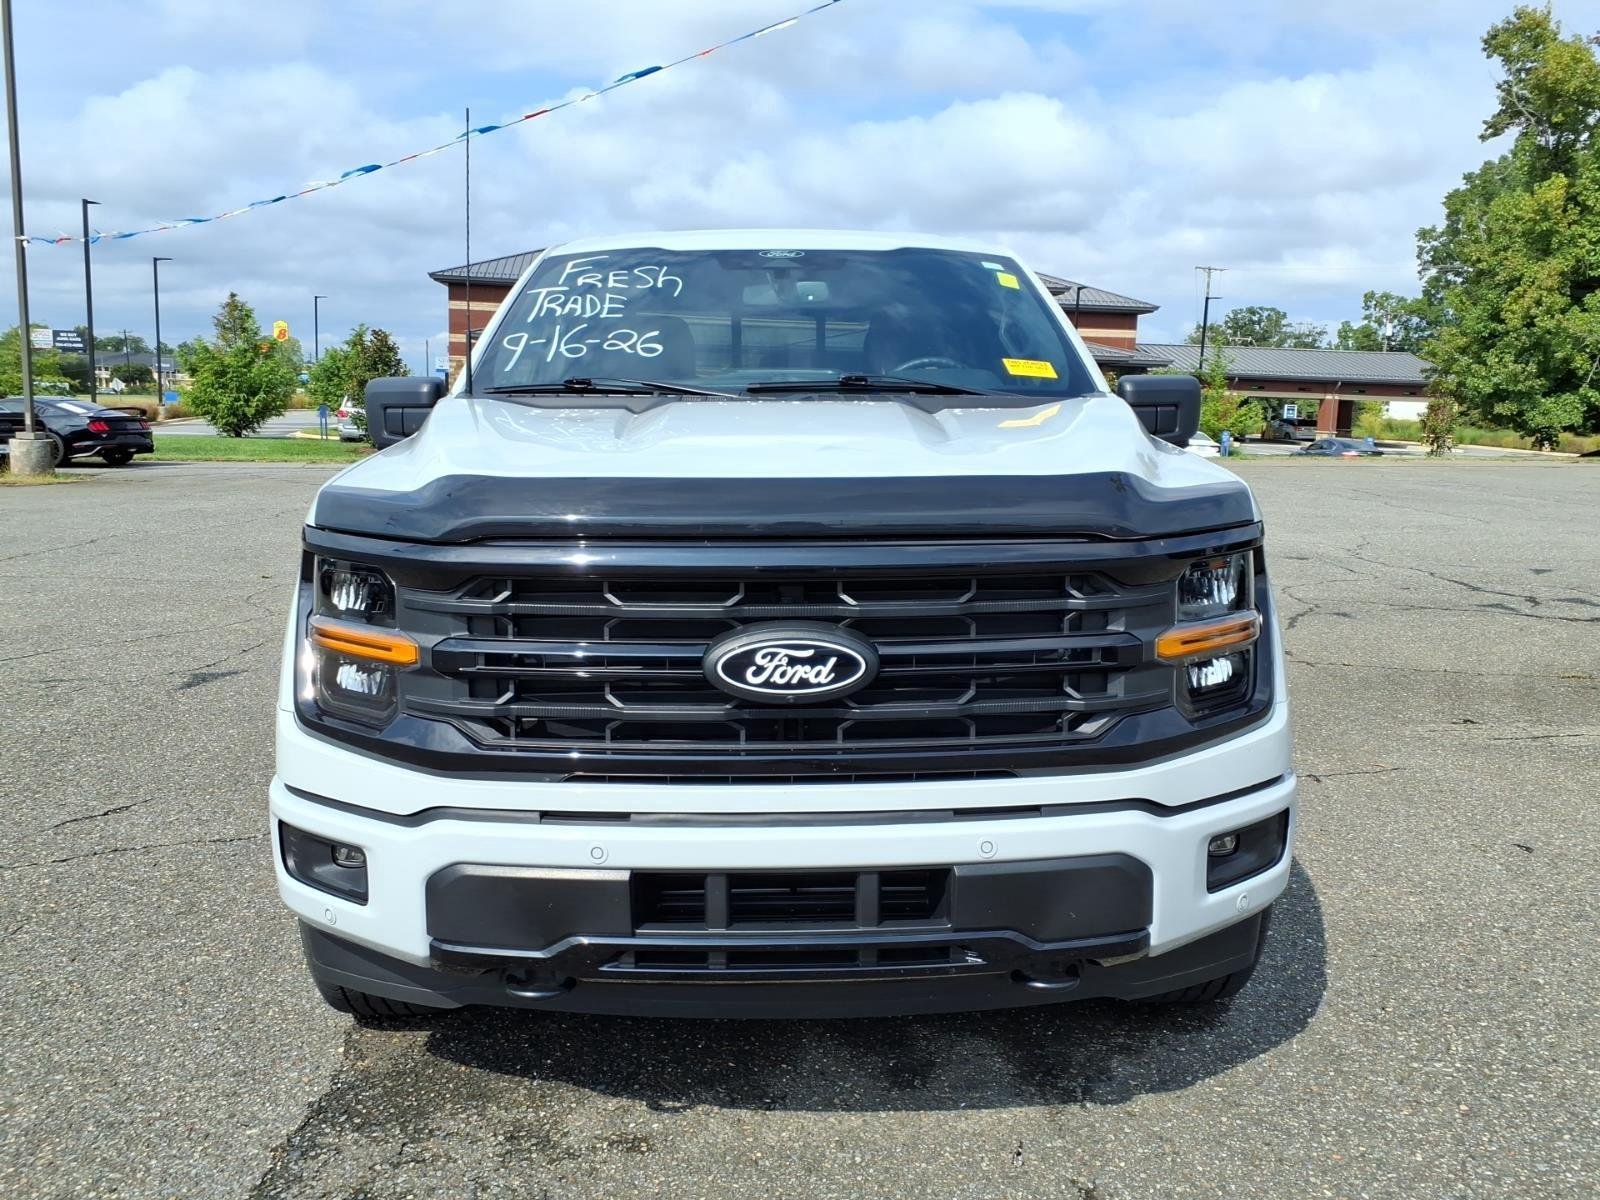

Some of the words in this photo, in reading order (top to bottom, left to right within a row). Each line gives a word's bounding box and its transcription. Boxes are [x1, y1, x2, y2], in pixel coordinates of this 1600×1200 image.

[526, 286, 628, 323] TRADE
[276, 328, 287, 339] 8
[502, 323, 664, 372] 9-16-26
[745, 647, 838, 685] Ford
